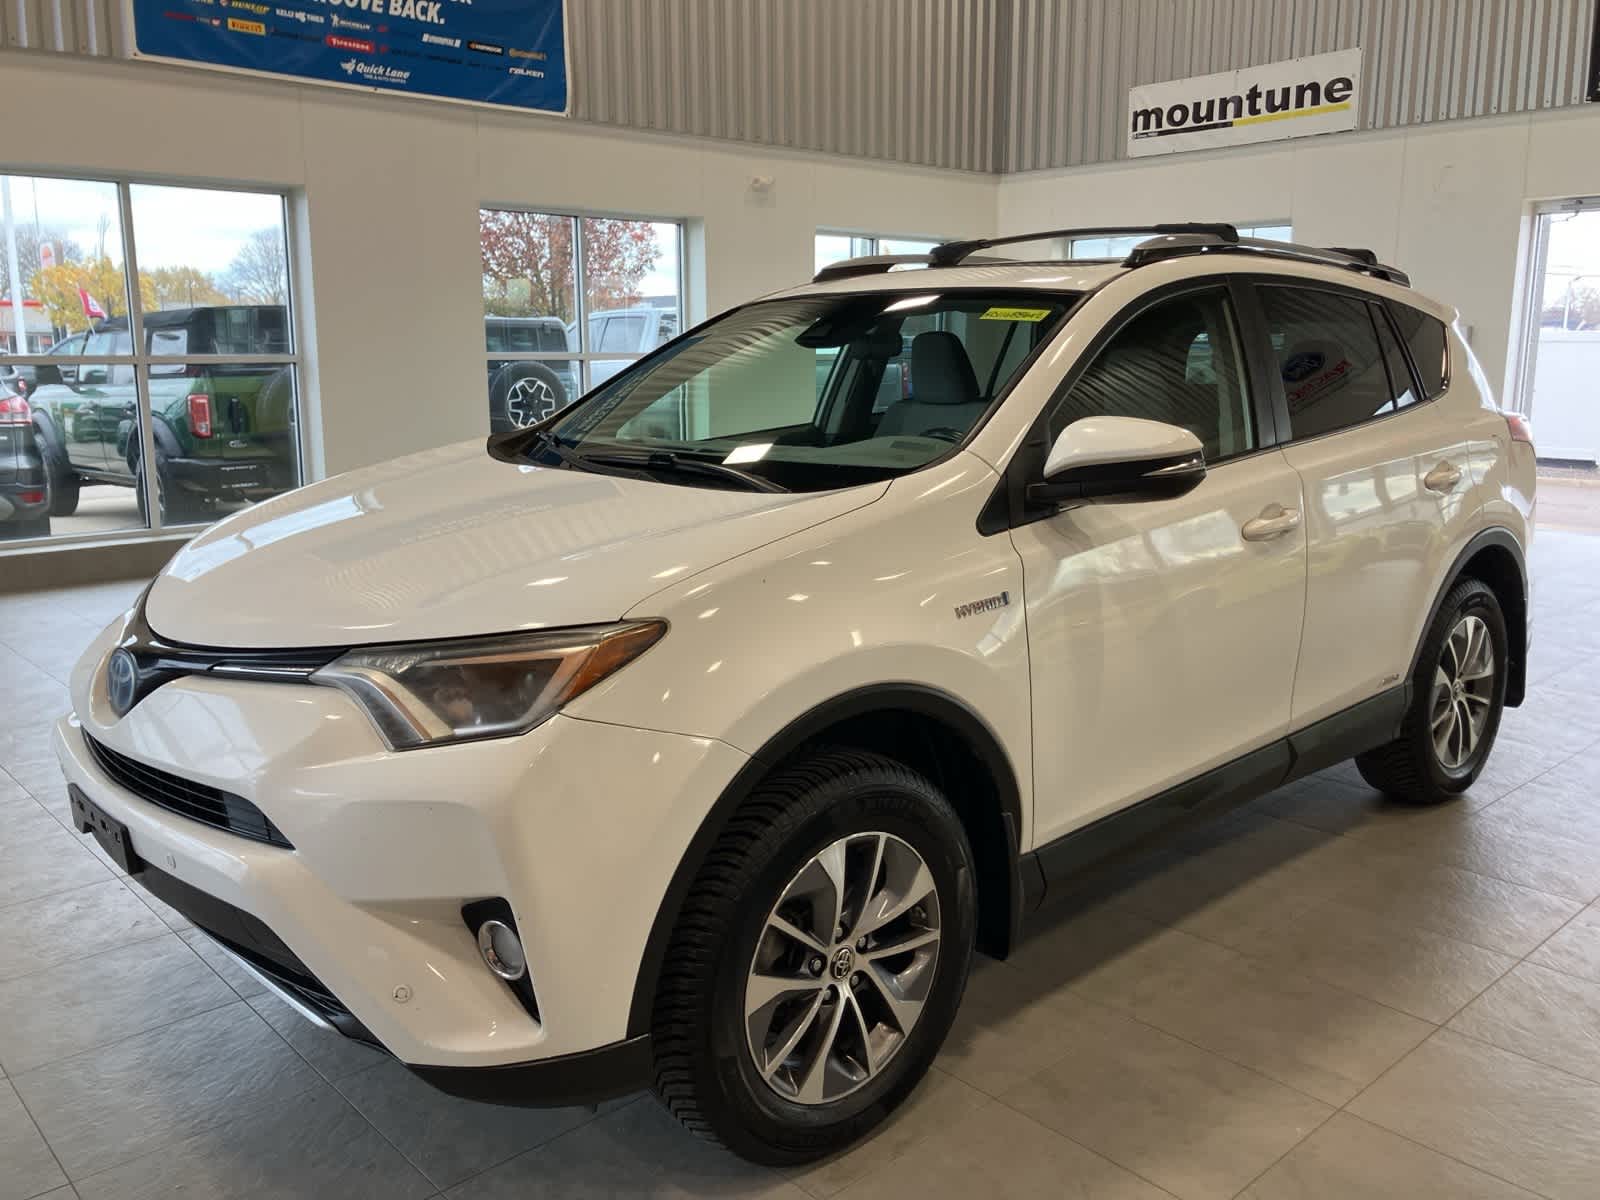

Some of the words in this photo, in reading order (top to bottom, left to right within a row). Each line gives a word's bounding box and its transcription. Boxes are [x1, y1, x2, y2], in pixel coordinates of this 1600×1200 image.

[388, 0, 446, 24] BACK.
[355, 62, 385, 76] Quick
[385, 66, 411, 79] Lane
[1132, 76, 1353, 132] mountune
[954, 595, 1003, 619] HYBRID
